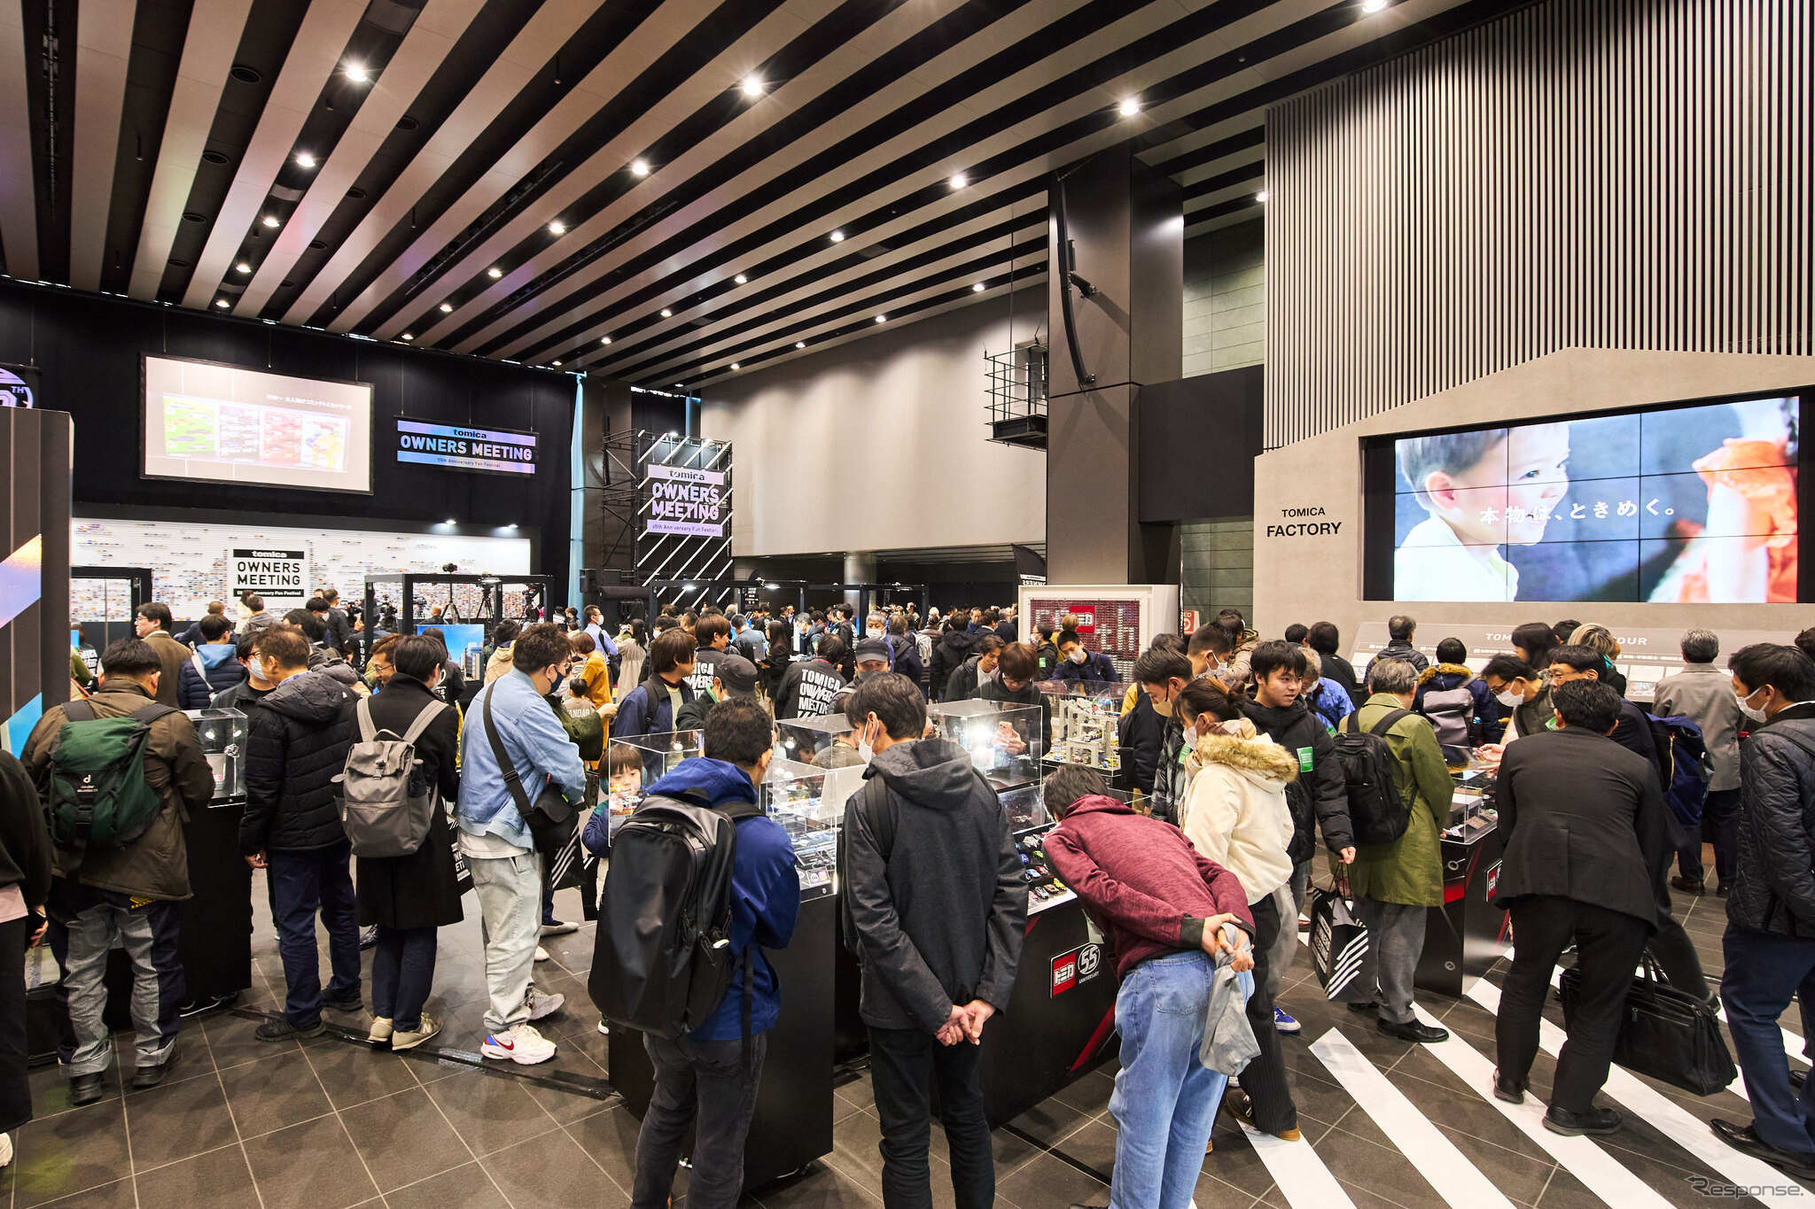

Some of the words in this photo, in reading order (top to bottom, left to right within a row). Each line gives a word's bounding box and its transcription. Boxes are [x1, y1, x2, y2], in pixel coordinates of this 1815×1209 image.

[453, 429, 487, 439] tomica
[400, 435, 467, 454] OWNERS
[471, 442, 533, 461] MEETING
[669, 470, 705, 481] tomica
[652, 482, 720, 504] OWNERS
[651, 500, 719, 520] MEETING
[1281, 507, 1326, 518] TOMICA
[1480, 497, 1675, 526] 本物は、ときめく。
[1266, 521, 1342, 537] FACTORY
[237, 561, 300, 573] OWNERS
[237, 574, 301, 586] MEETING
[1486, 632, 1512, 642] TOM
[1614, 635, 1648, 646] OUR
[801, 668, 841, 691] TOMICA
